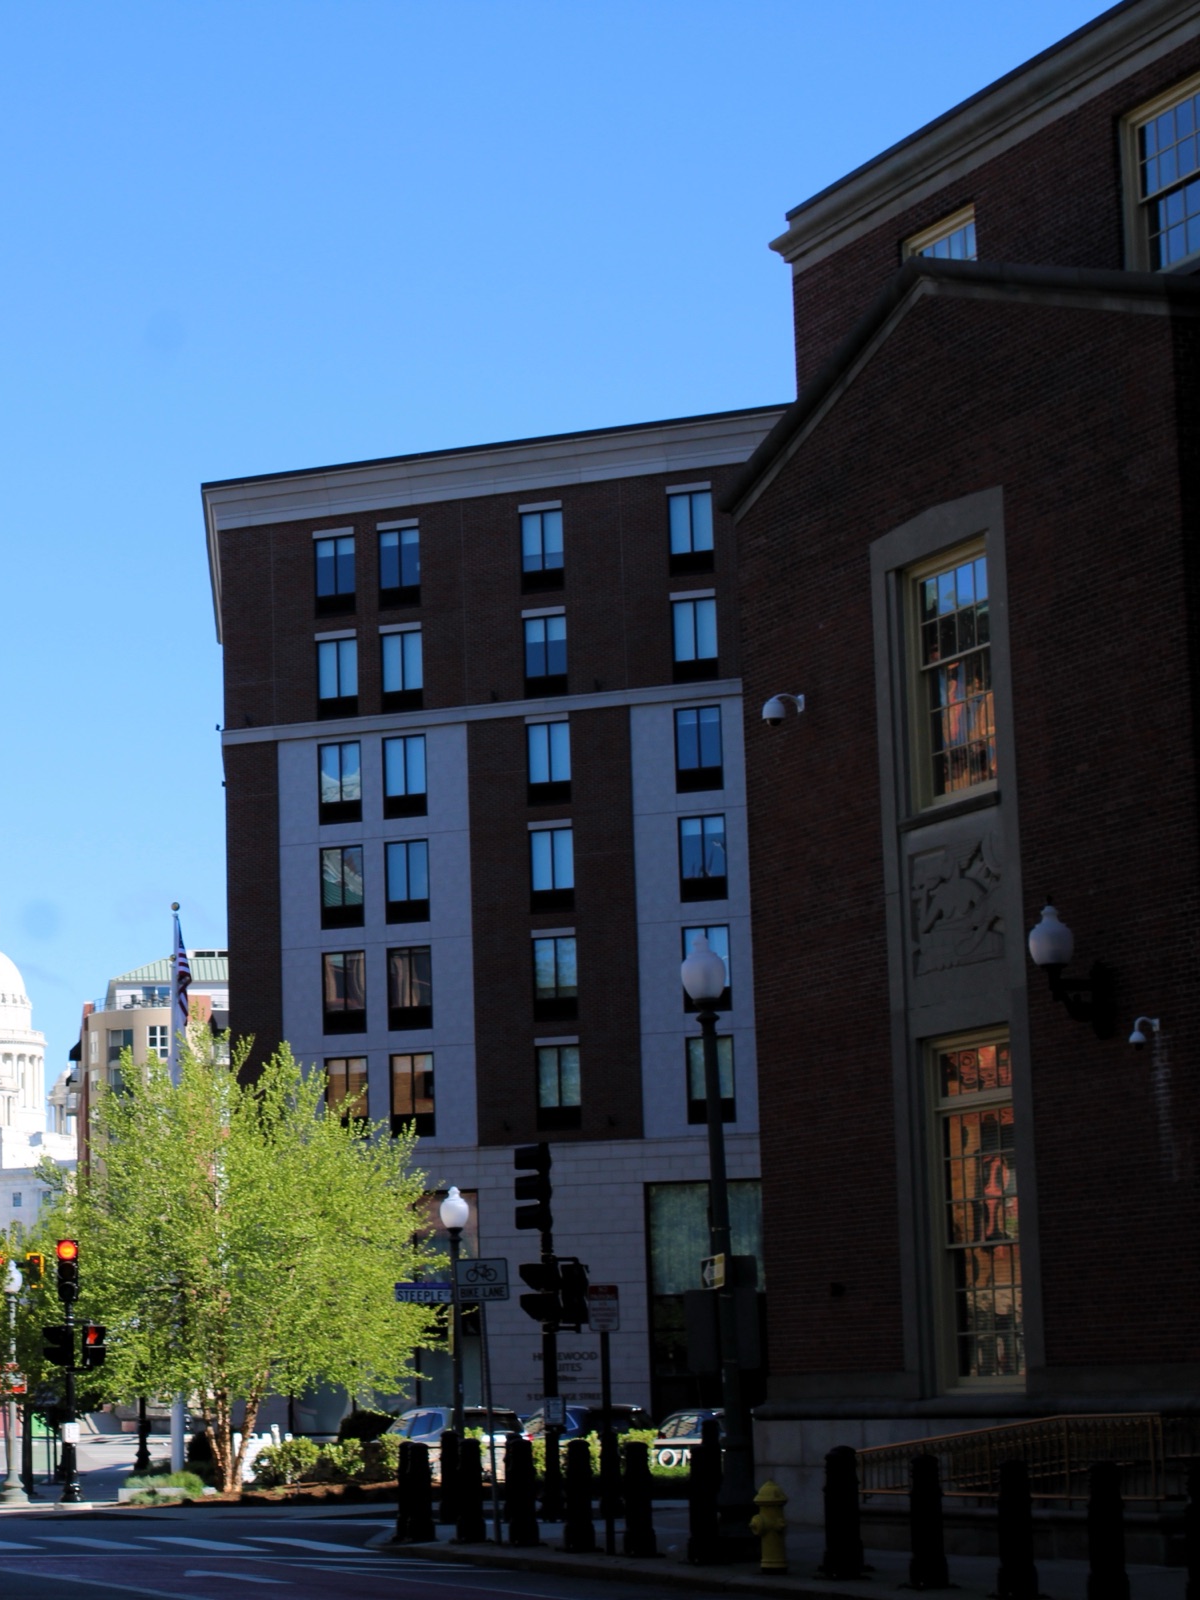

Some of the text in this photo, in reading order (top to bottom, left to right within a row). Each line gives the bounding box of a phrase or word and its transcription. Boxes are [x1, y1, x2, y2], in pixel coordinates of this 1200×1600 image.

[397, 1290, 443, 1302] STEEPLE
[460, 1286, 505, 1298] BIKE LANE
